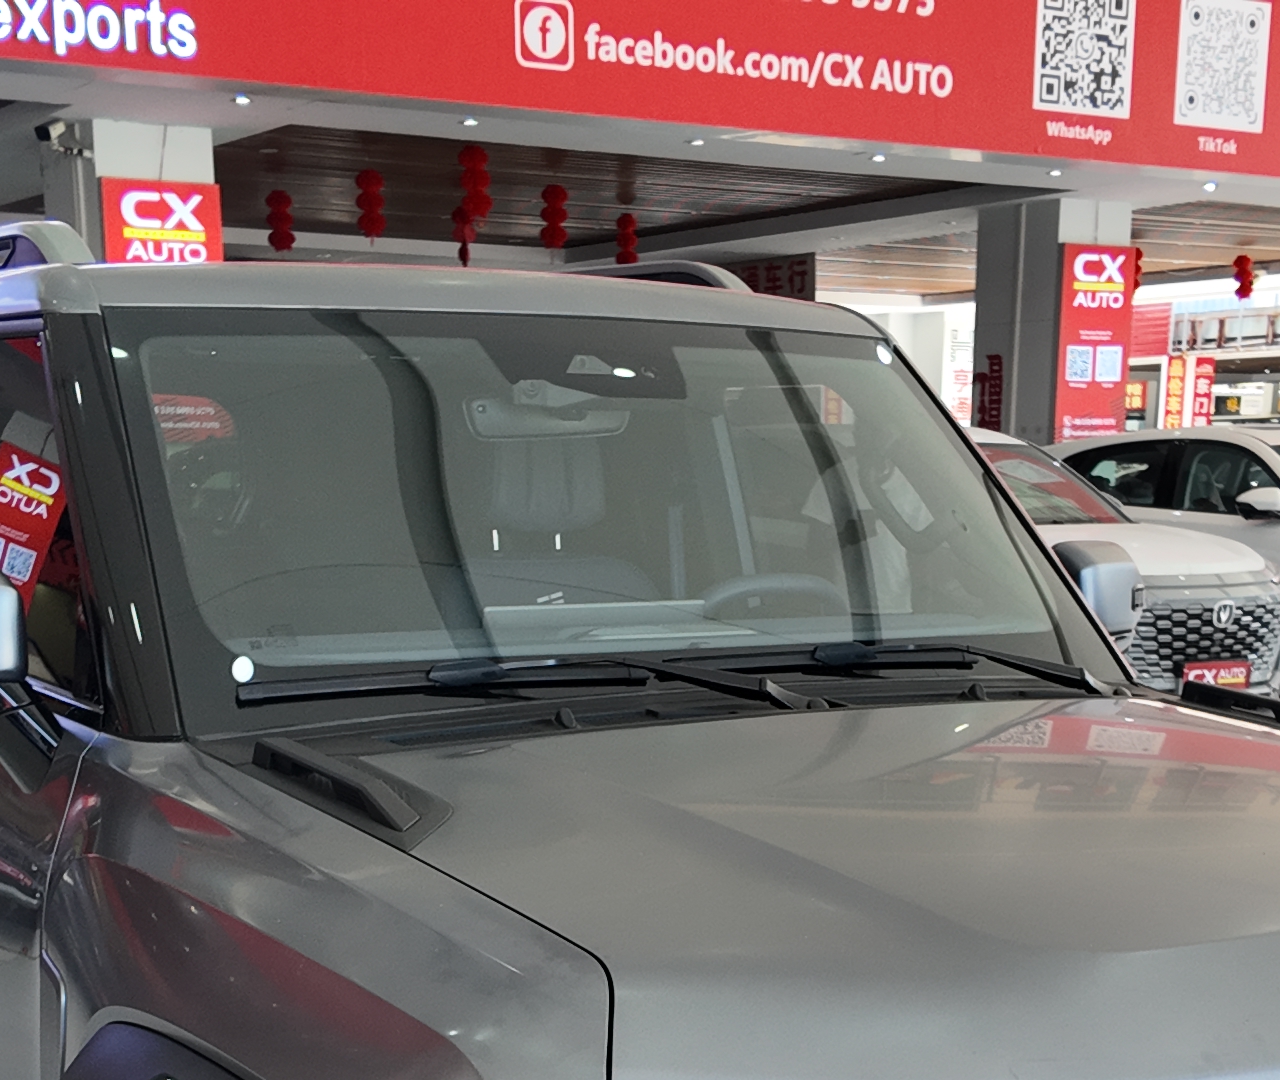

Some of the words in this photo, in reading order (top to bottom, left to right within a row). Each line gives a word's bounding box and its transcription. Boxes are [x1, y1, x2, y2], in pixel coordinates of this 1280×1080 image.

[584, 22, 865, 89] facebook.com/CX
[870, 60, 954, 98] AUTO
[1045, 120, 1113, 146] WhatsApp
[1197, 136, 1238, 155] TikTok
[120, 190, 206, 232] CX
[125, 239, 208, 263] AUTO
[1072, 253, 1127, 283] CX
[1072, 291, 1125, 309] AUTO
[1187, 667, 1218, 685] CX
[1217, 666, 1247, 679] AUTO
